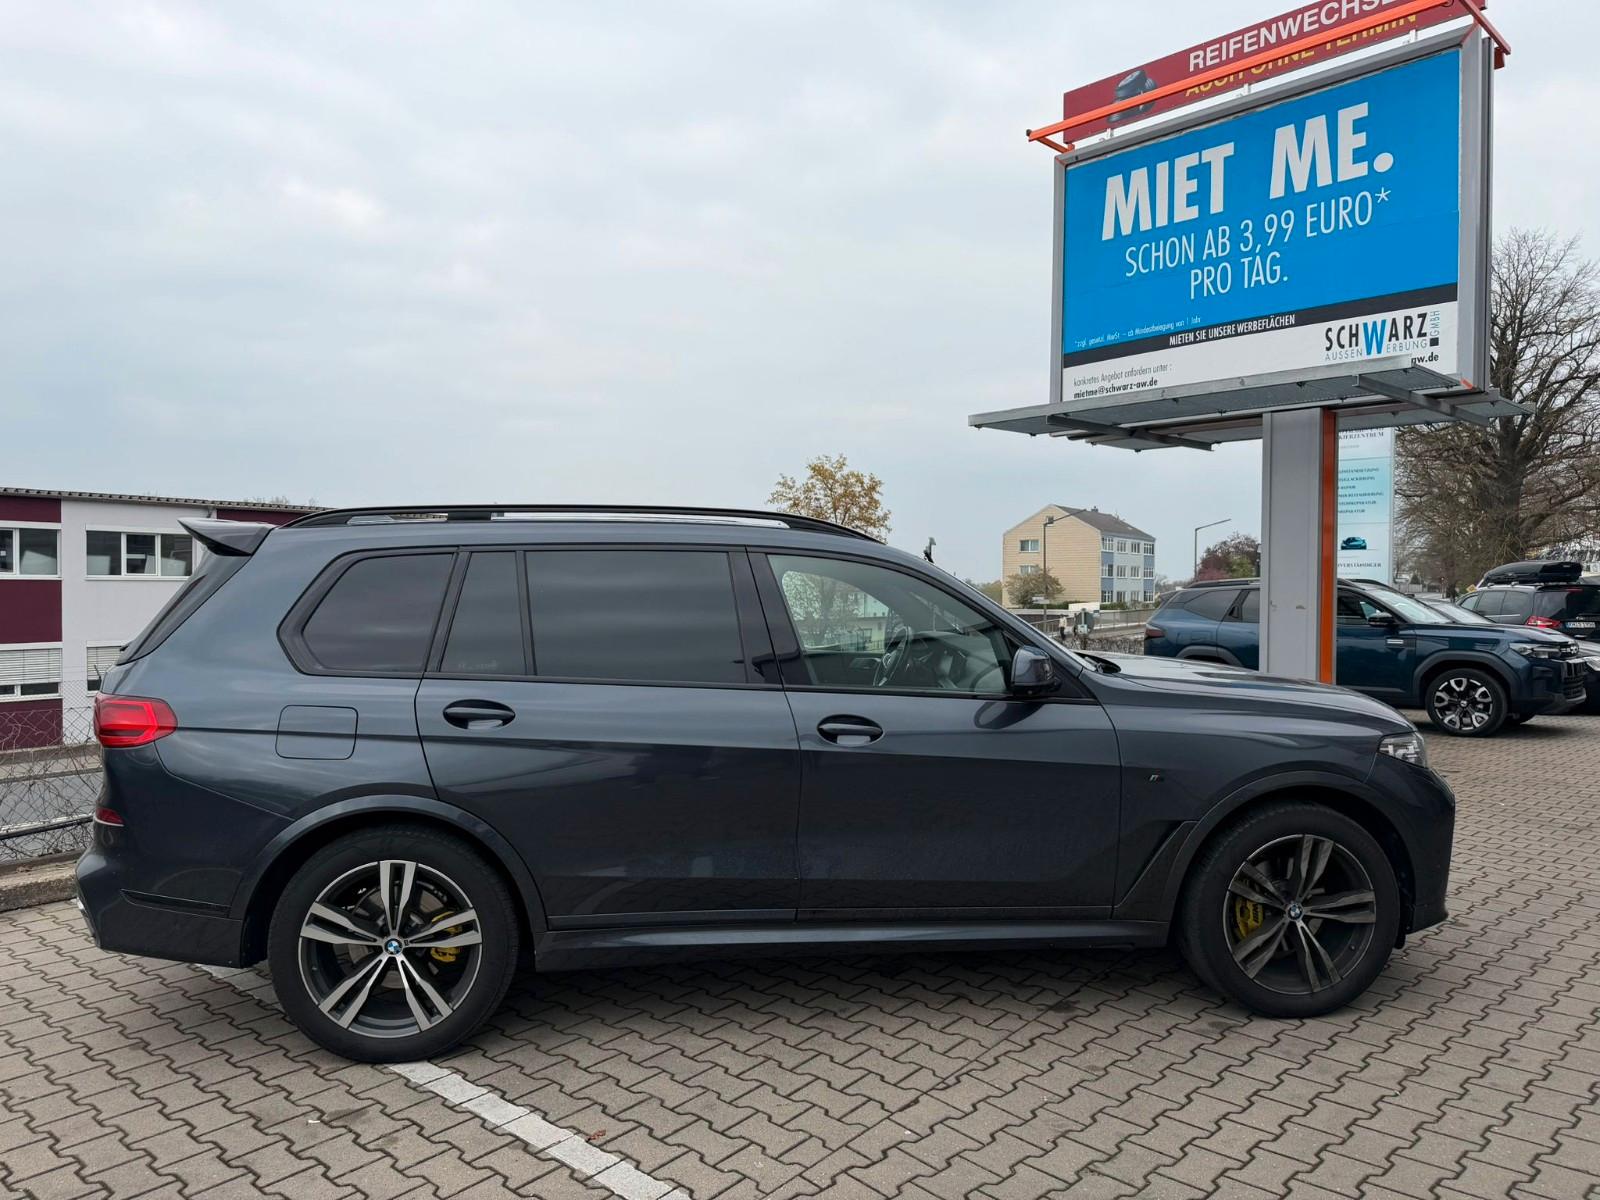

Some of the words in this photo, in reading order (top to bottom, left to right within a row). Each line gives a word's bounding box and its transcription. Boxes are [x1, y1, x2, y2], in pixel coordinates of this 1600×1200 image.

[1102, 142, 1234, 241] MIET
[1269, 102, 1394, 199] ME.
[1125, 232, 1195, 277] SCHON
[1203, 225, 1231, 261] AB
[1240, 209, 1295, 253] 3,99
[1190, 262, 1232, 300] PRO
[1240, 251, 1289, 289] TAG.
[1169, 332, 1194, 346] MIETEN
[1195, 329, 1207, 341] SIE
[1208, 324, 1236, 339] UNSERE
[1236, 314, 1296, 333] WERBEFLÄCHEN
[1325, 312, 1428, 356] SCHWARZ
[1073, 376, 1100, 387] konkretes
[1101, 371, 1123, 383] Angebot
[1124, 366, 1151, 377] anfordern
[1073, 377, 1158, 399] mietme@schwarz-aw.de
